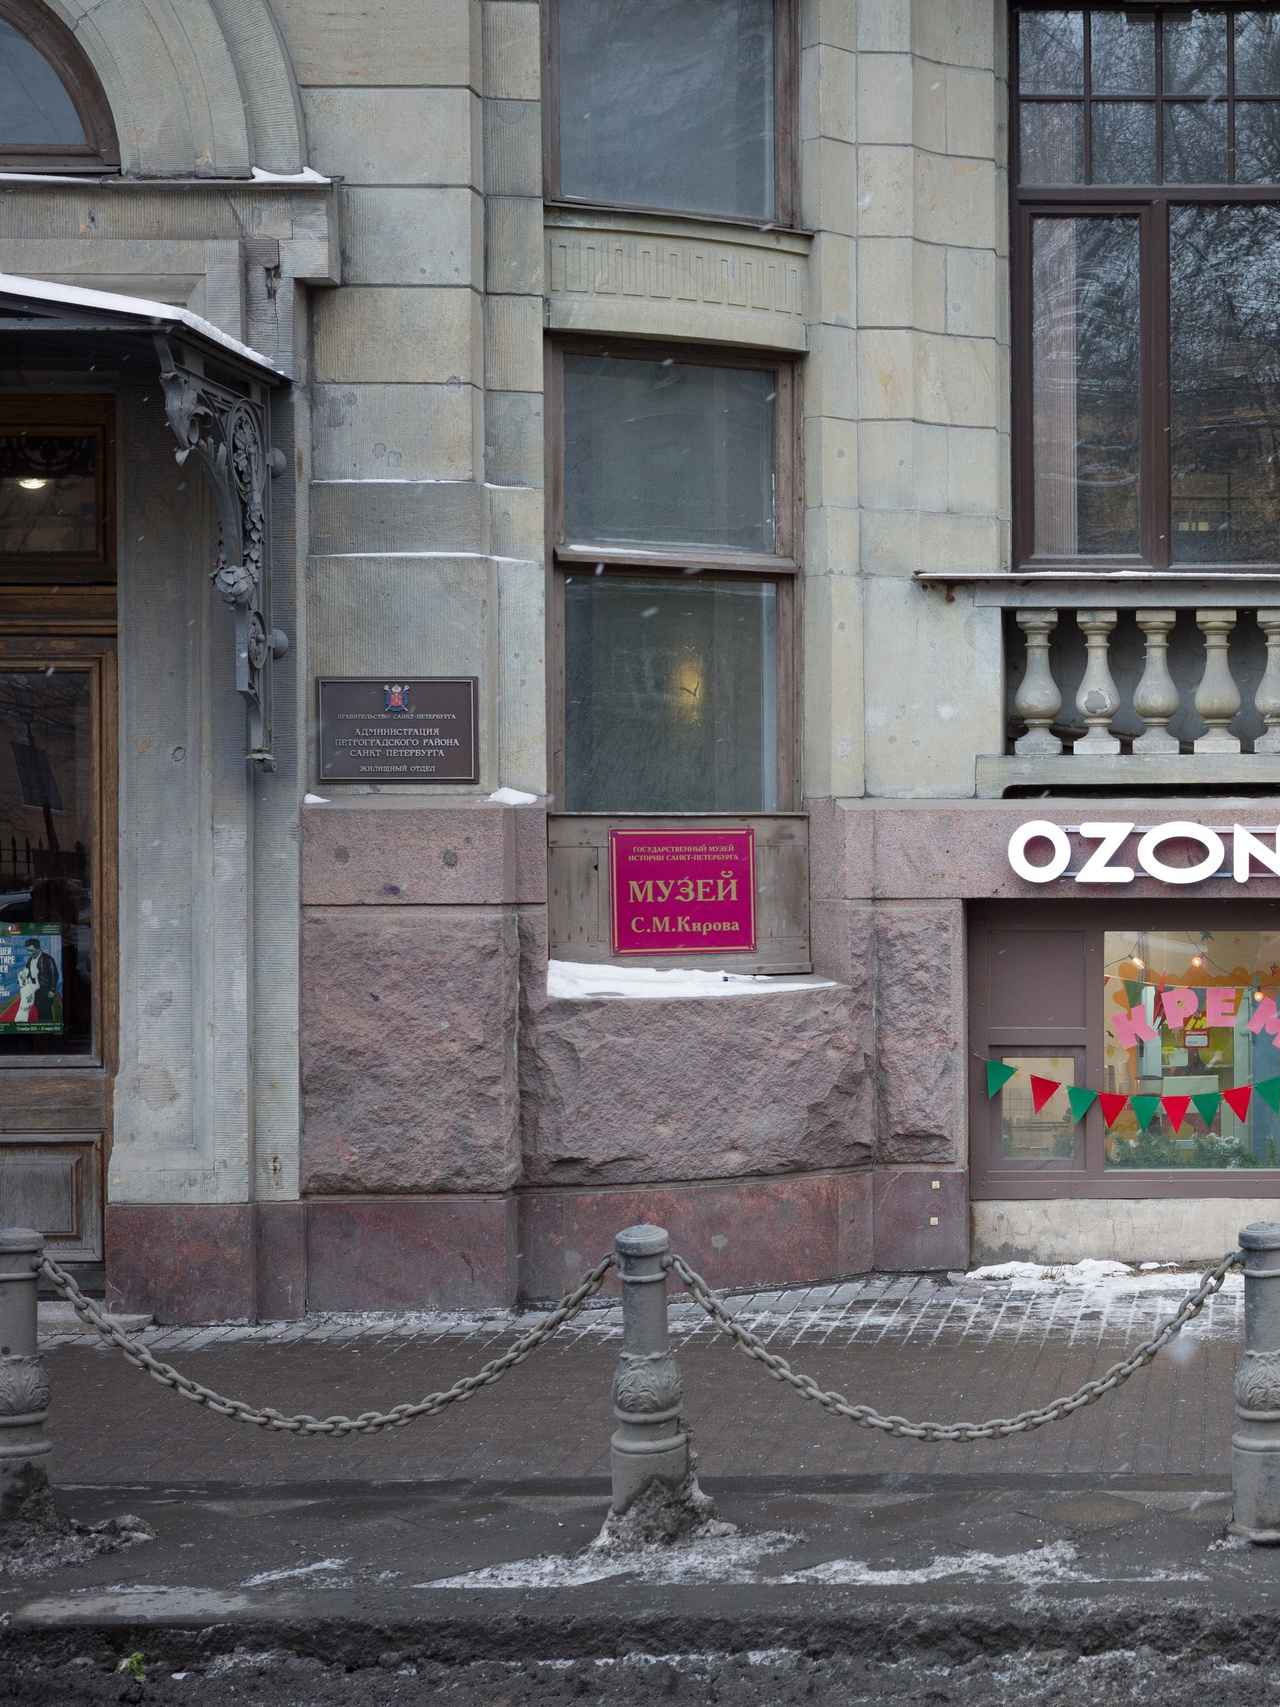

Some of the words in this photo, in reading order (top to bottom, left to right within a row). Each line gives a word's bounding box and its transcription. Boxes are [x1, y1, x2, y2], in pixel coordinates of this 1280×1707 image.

[354, 728, 440, 736] АДМИНИСТРАЦИЯ
[334, 738, 419, 747] ПЕТРОГРАДСКОГО
[423, 737, 459, 746] РАЙОНА
[350, 749, 445, 757] САНКТ-ПЕТЕРБУРГА
[633, 844, 707, 853] ГОСУДАРСТВЕННЫЙ
[709, 844, 734, 852] МУЗЕЙ
[628, 870, 738, 903] МУЗЕЙ
[630, 916, 740, 936] С.М.Кирова
